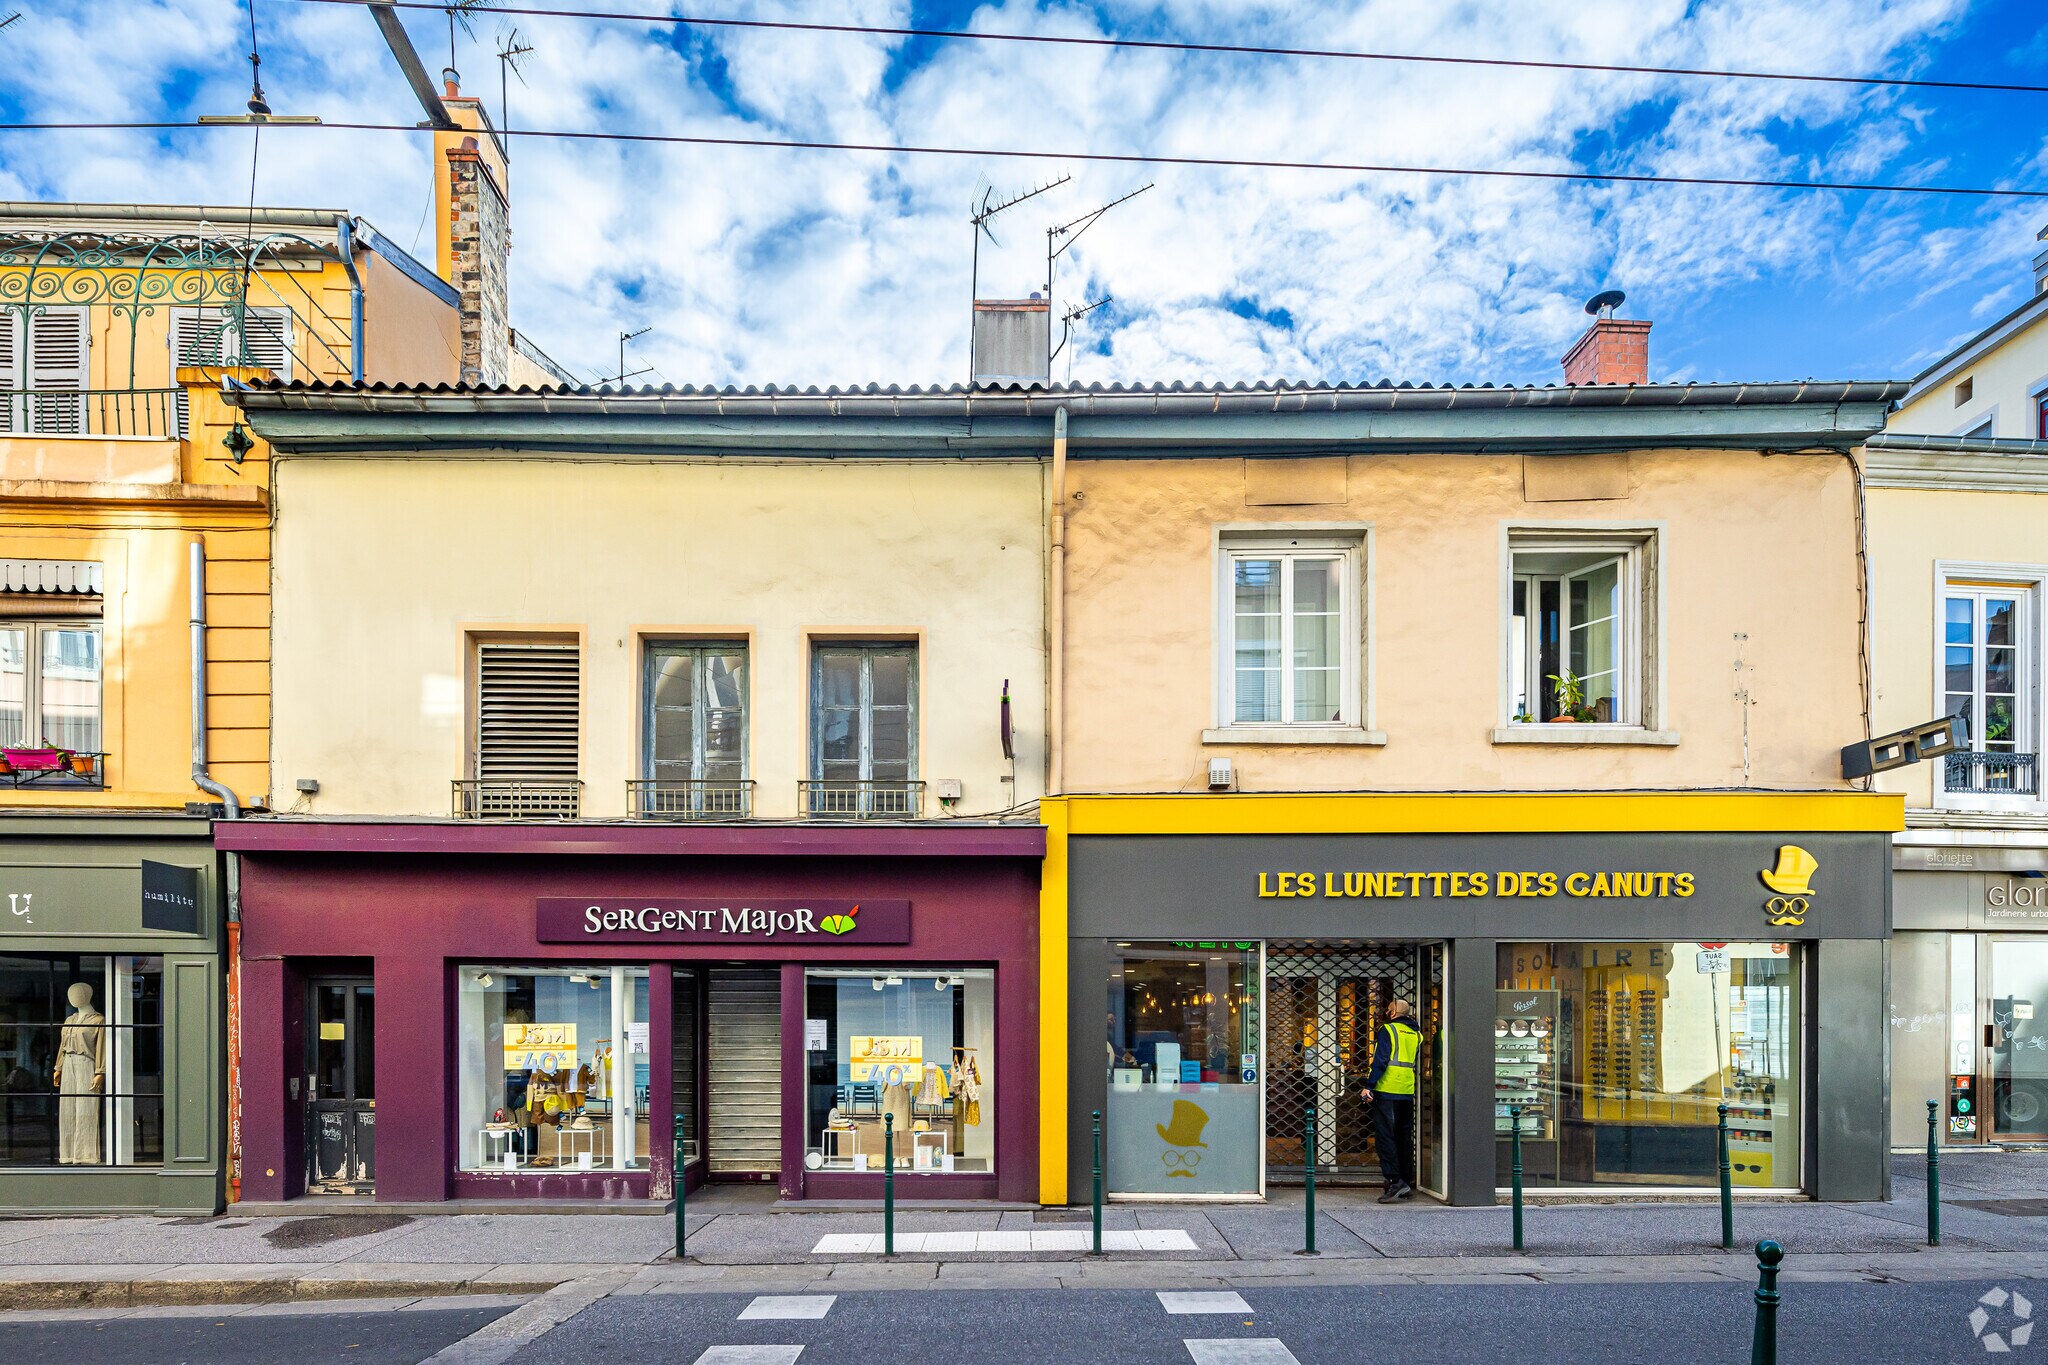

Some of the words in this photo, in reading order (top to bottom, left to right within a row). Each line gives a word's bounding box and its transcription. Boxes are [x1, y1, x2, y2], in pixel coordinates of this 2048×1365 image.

[1258, 872, 1317, 898] LES
[1323, 872, 1490, 898] LUNETTES
[1495, 872, 1559, 898] DES
[1564, 872, 1696, 898] CANUTS
[1987, 908, 2027, 918] Jardinerie
[1516, 948, 1664, 974] SOLAIRE
